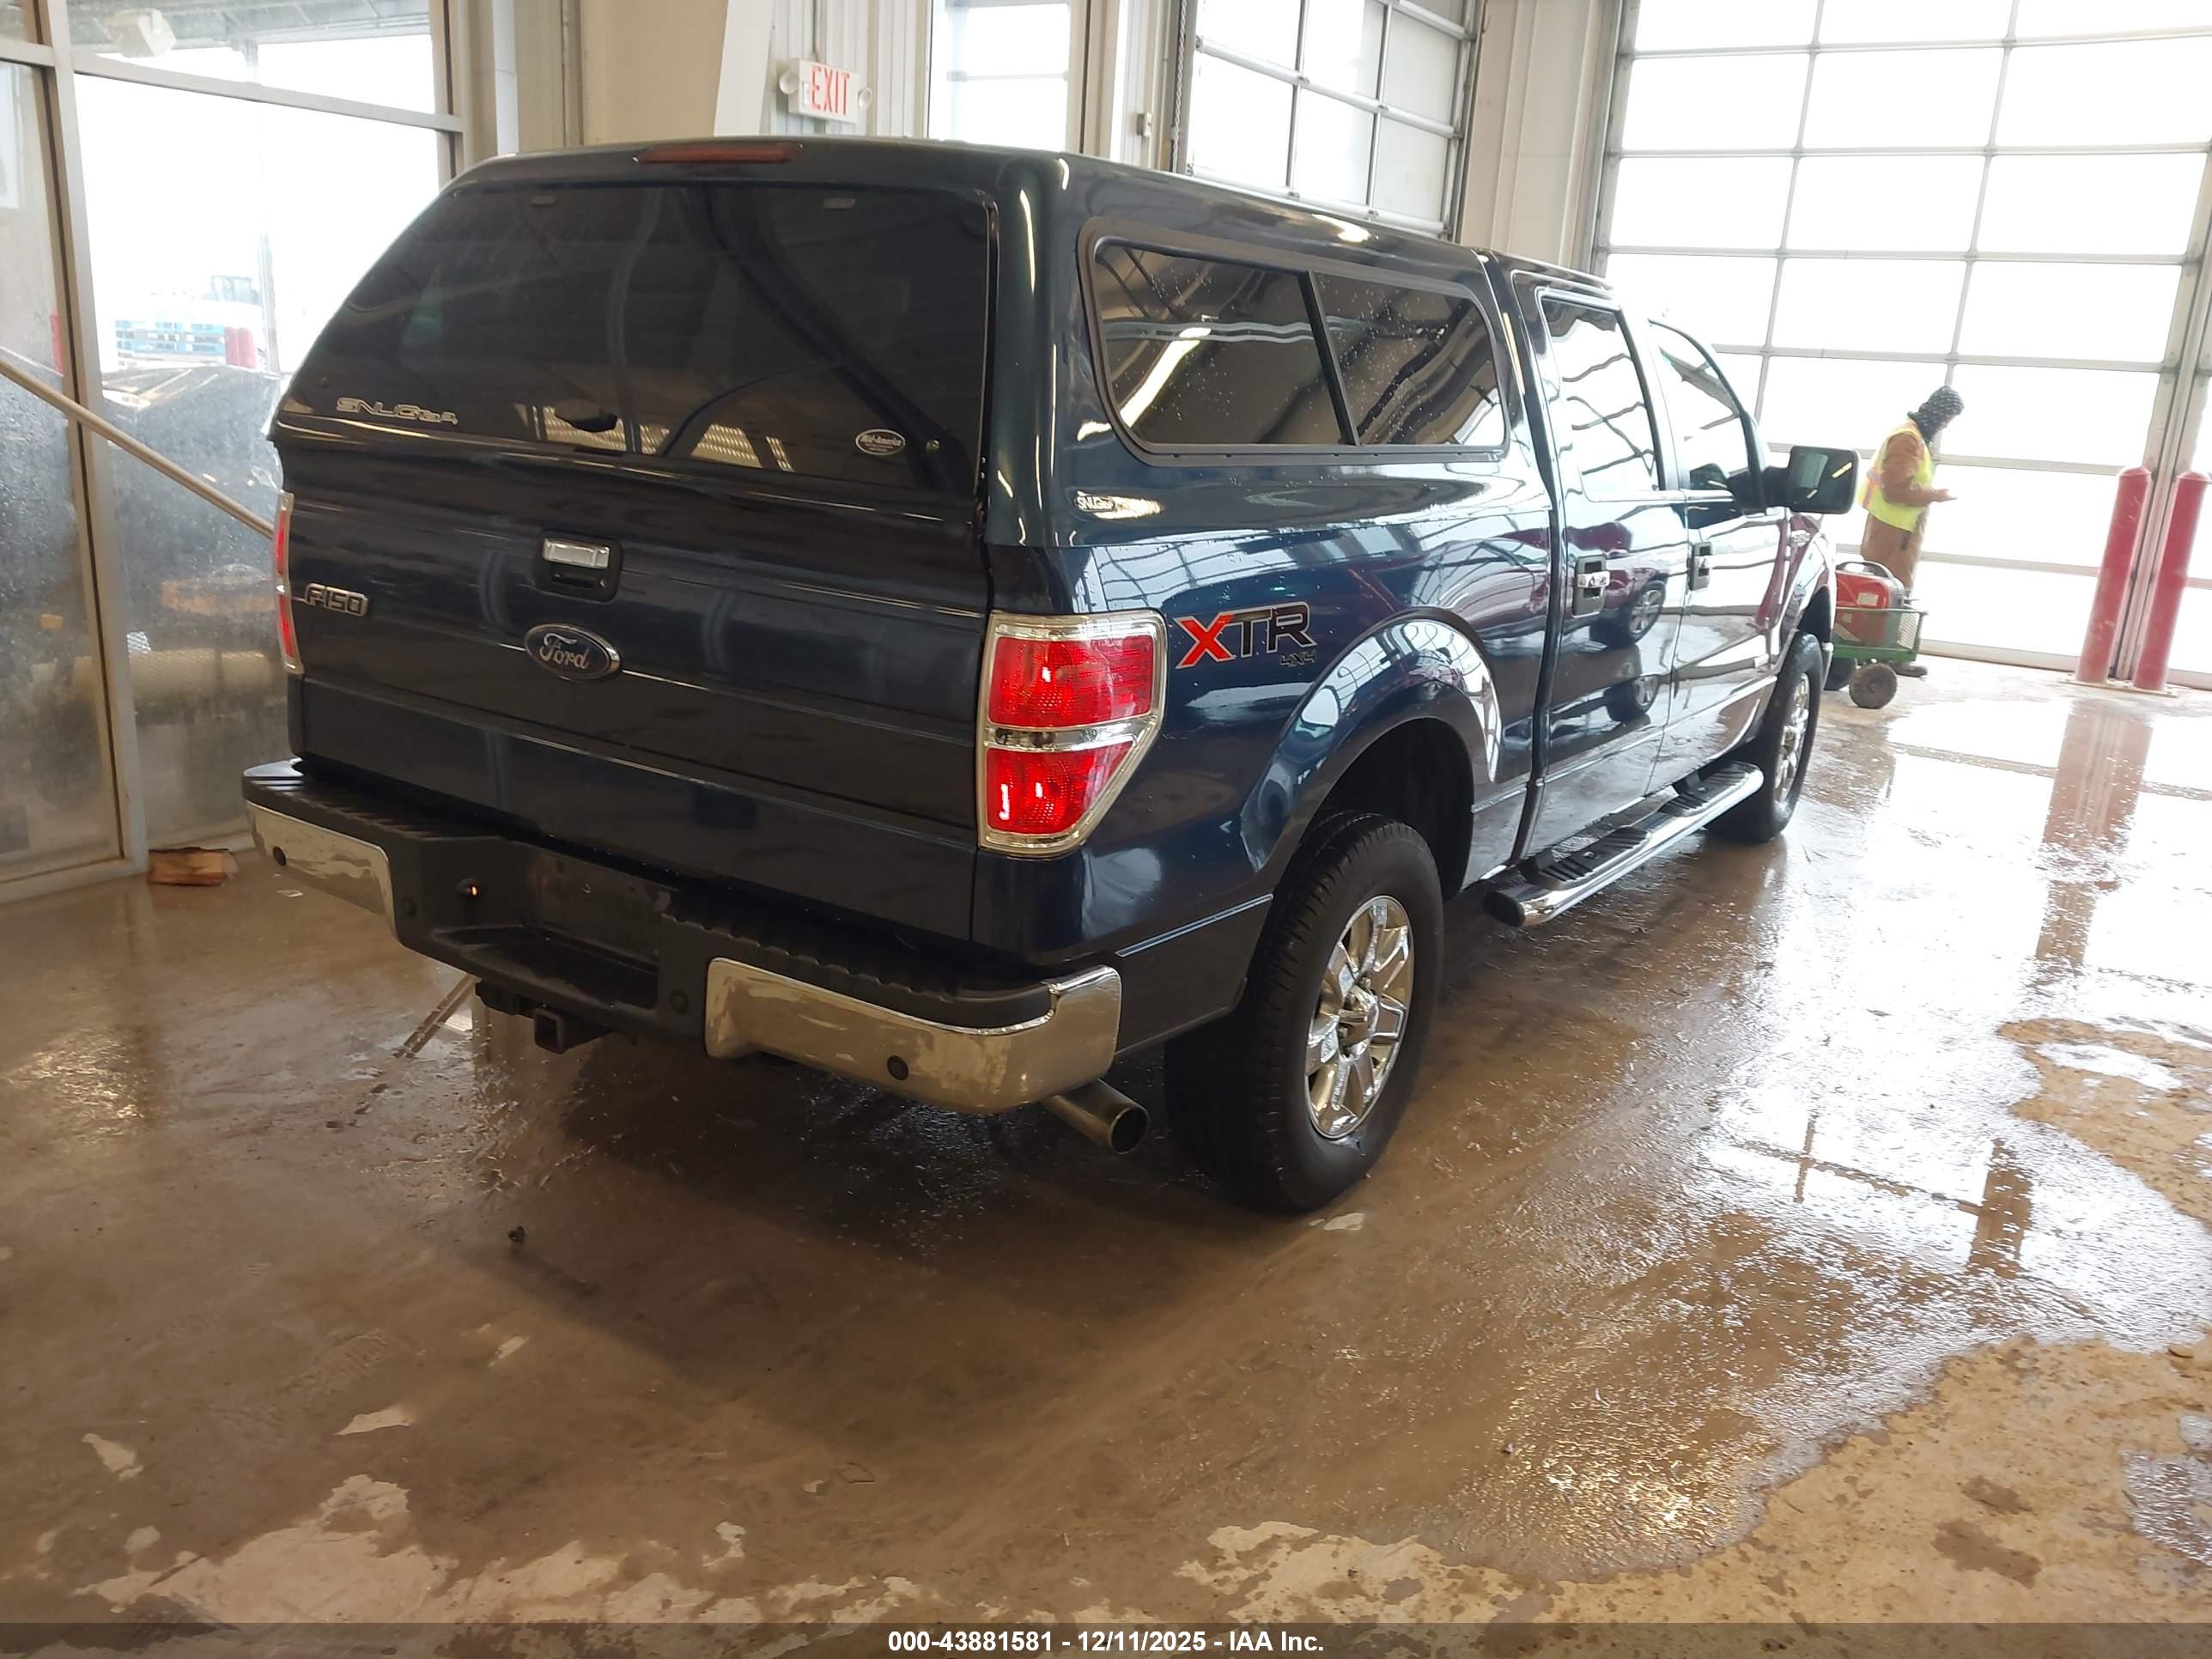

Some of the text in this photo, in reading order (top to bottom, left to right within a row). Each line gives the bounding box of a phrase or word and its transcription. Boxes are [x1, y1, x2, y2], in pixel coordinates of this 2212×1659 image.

[810, 64, 850, 116] EXIT
[539, 632, 590, 670] Ford
[1172, 601, 1318, 670] XTR
